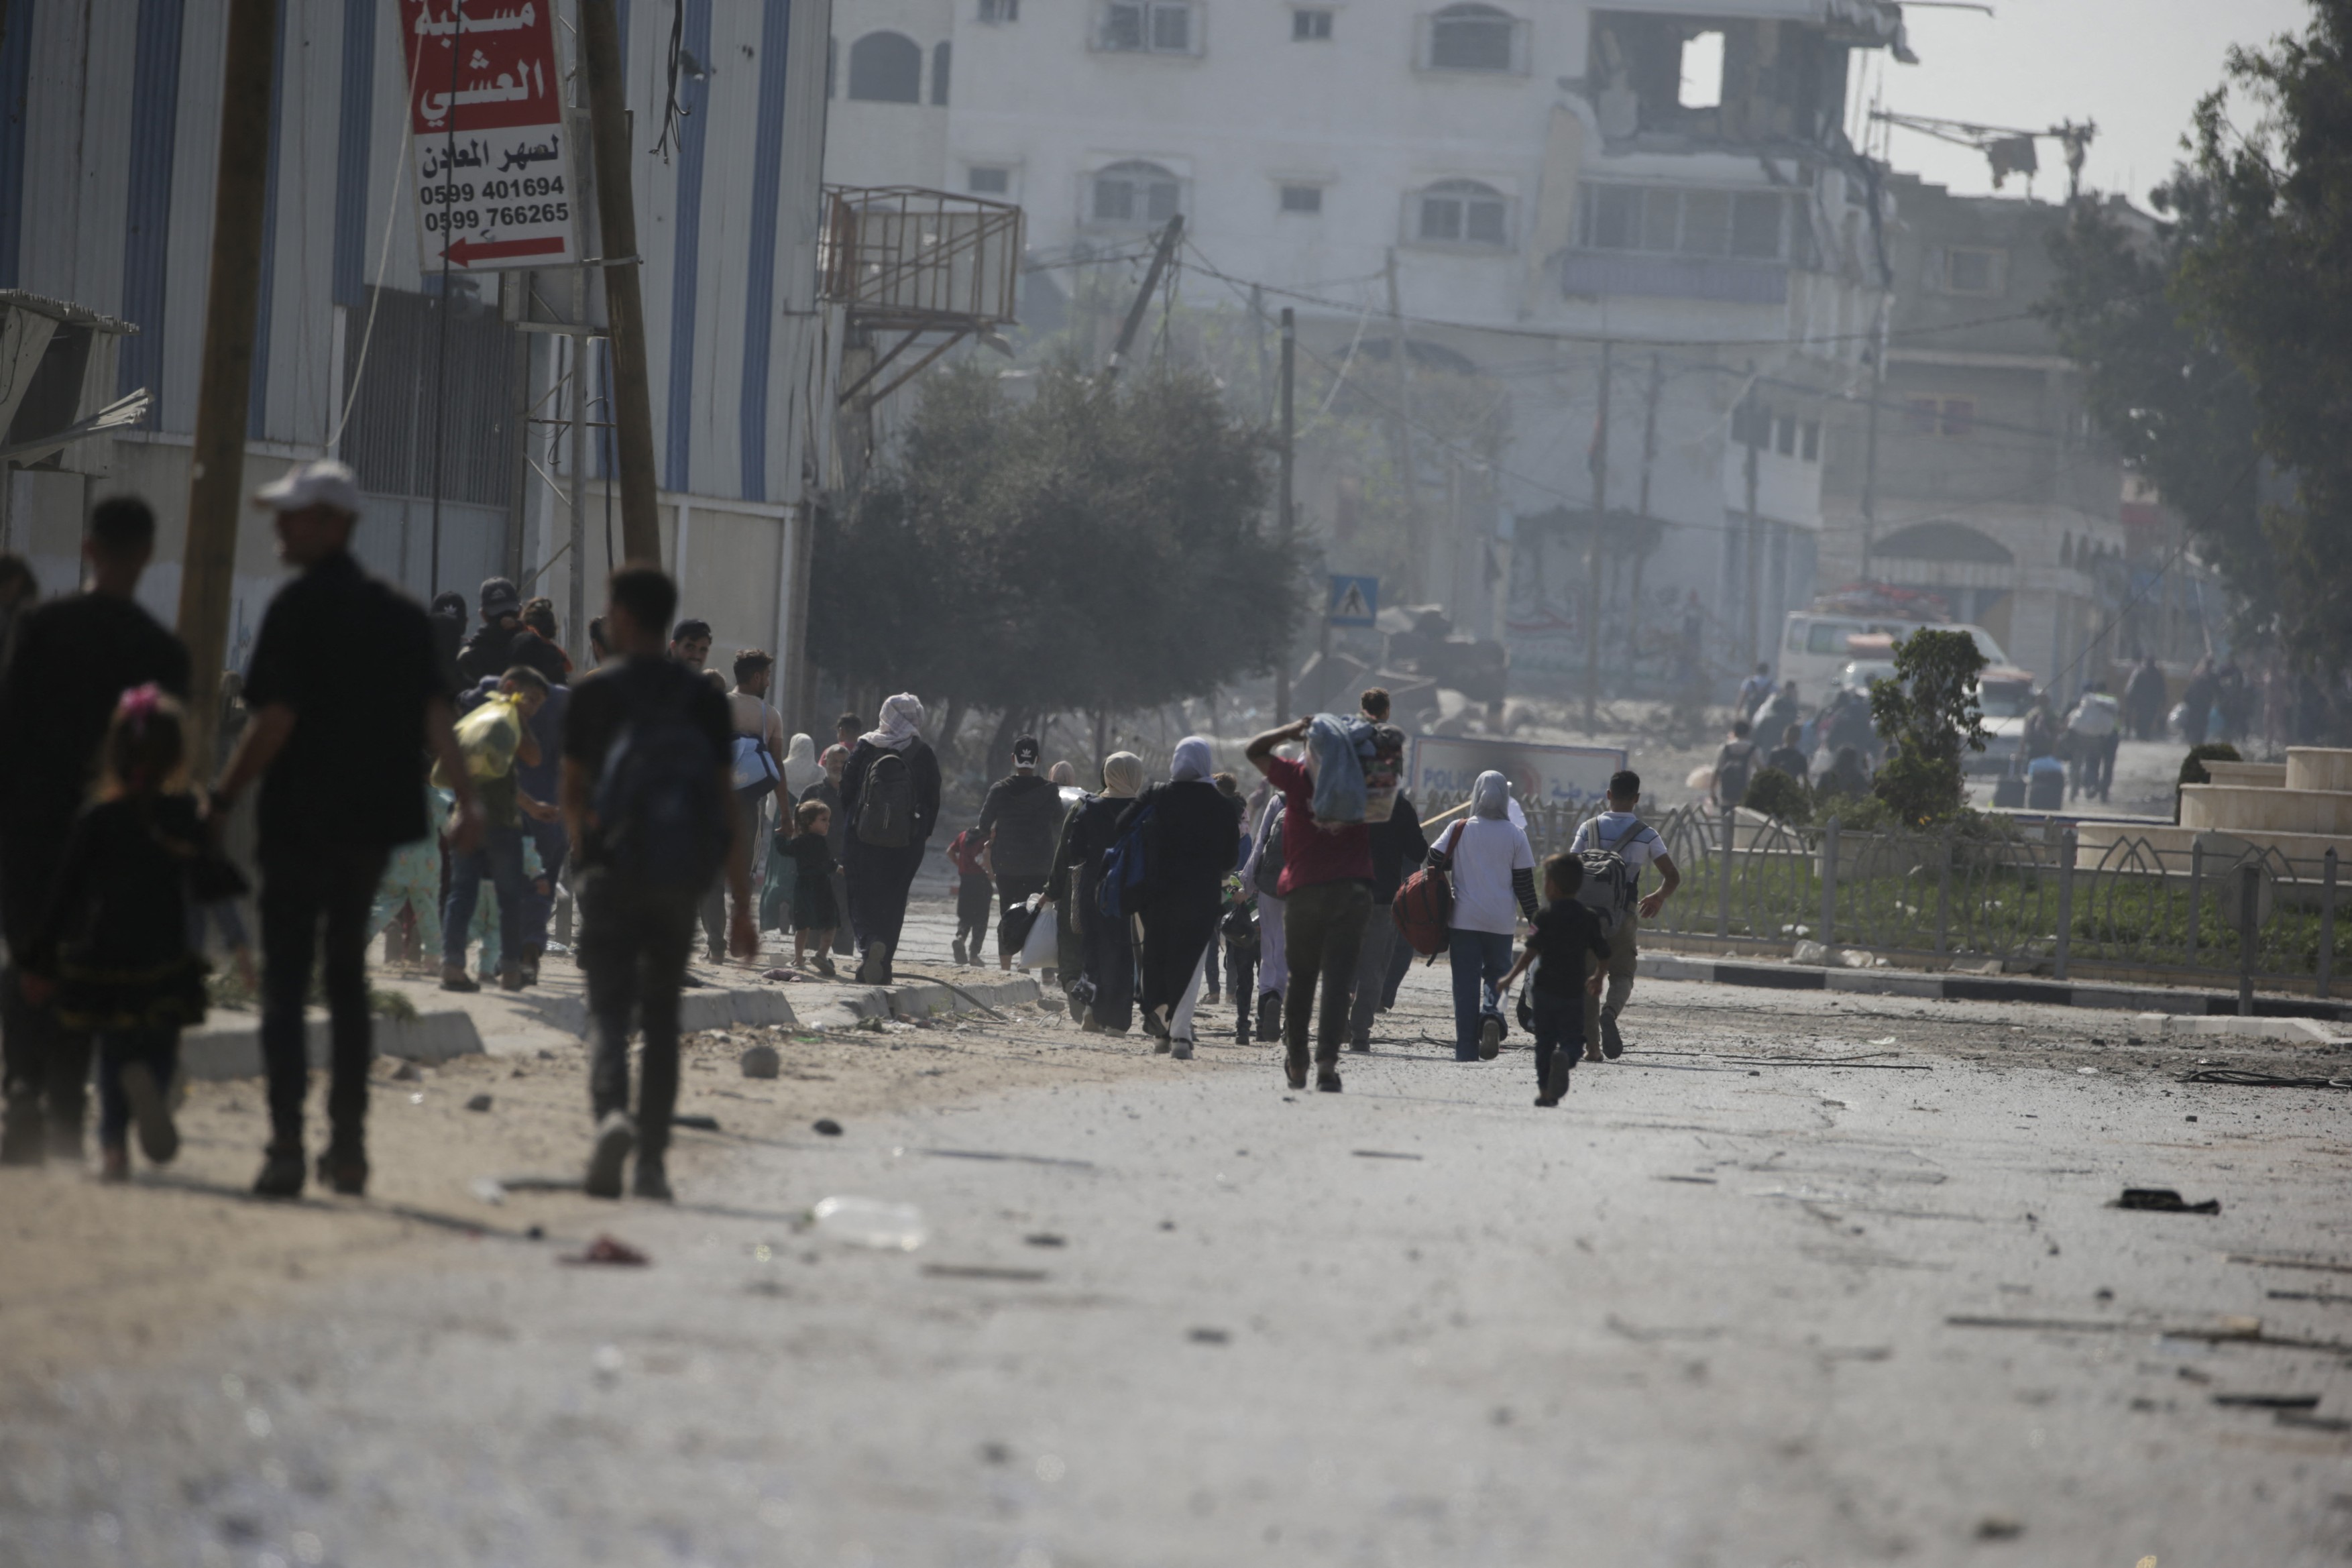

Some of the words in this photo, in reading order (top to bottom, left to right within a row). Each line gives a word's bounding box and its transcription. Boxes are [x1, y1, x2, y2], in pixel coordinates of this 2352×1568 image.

[420, 49, 544, 127] العشي
[423, 137, 489, 178] المعادن
[496, 133, 559, 172] لصهر
[420, 183, 474, 205] 0599
[482, 176, 564, 200] 401694
[425, 209, 479, 231] 0599
[486, 203, 569, 227] 766265
